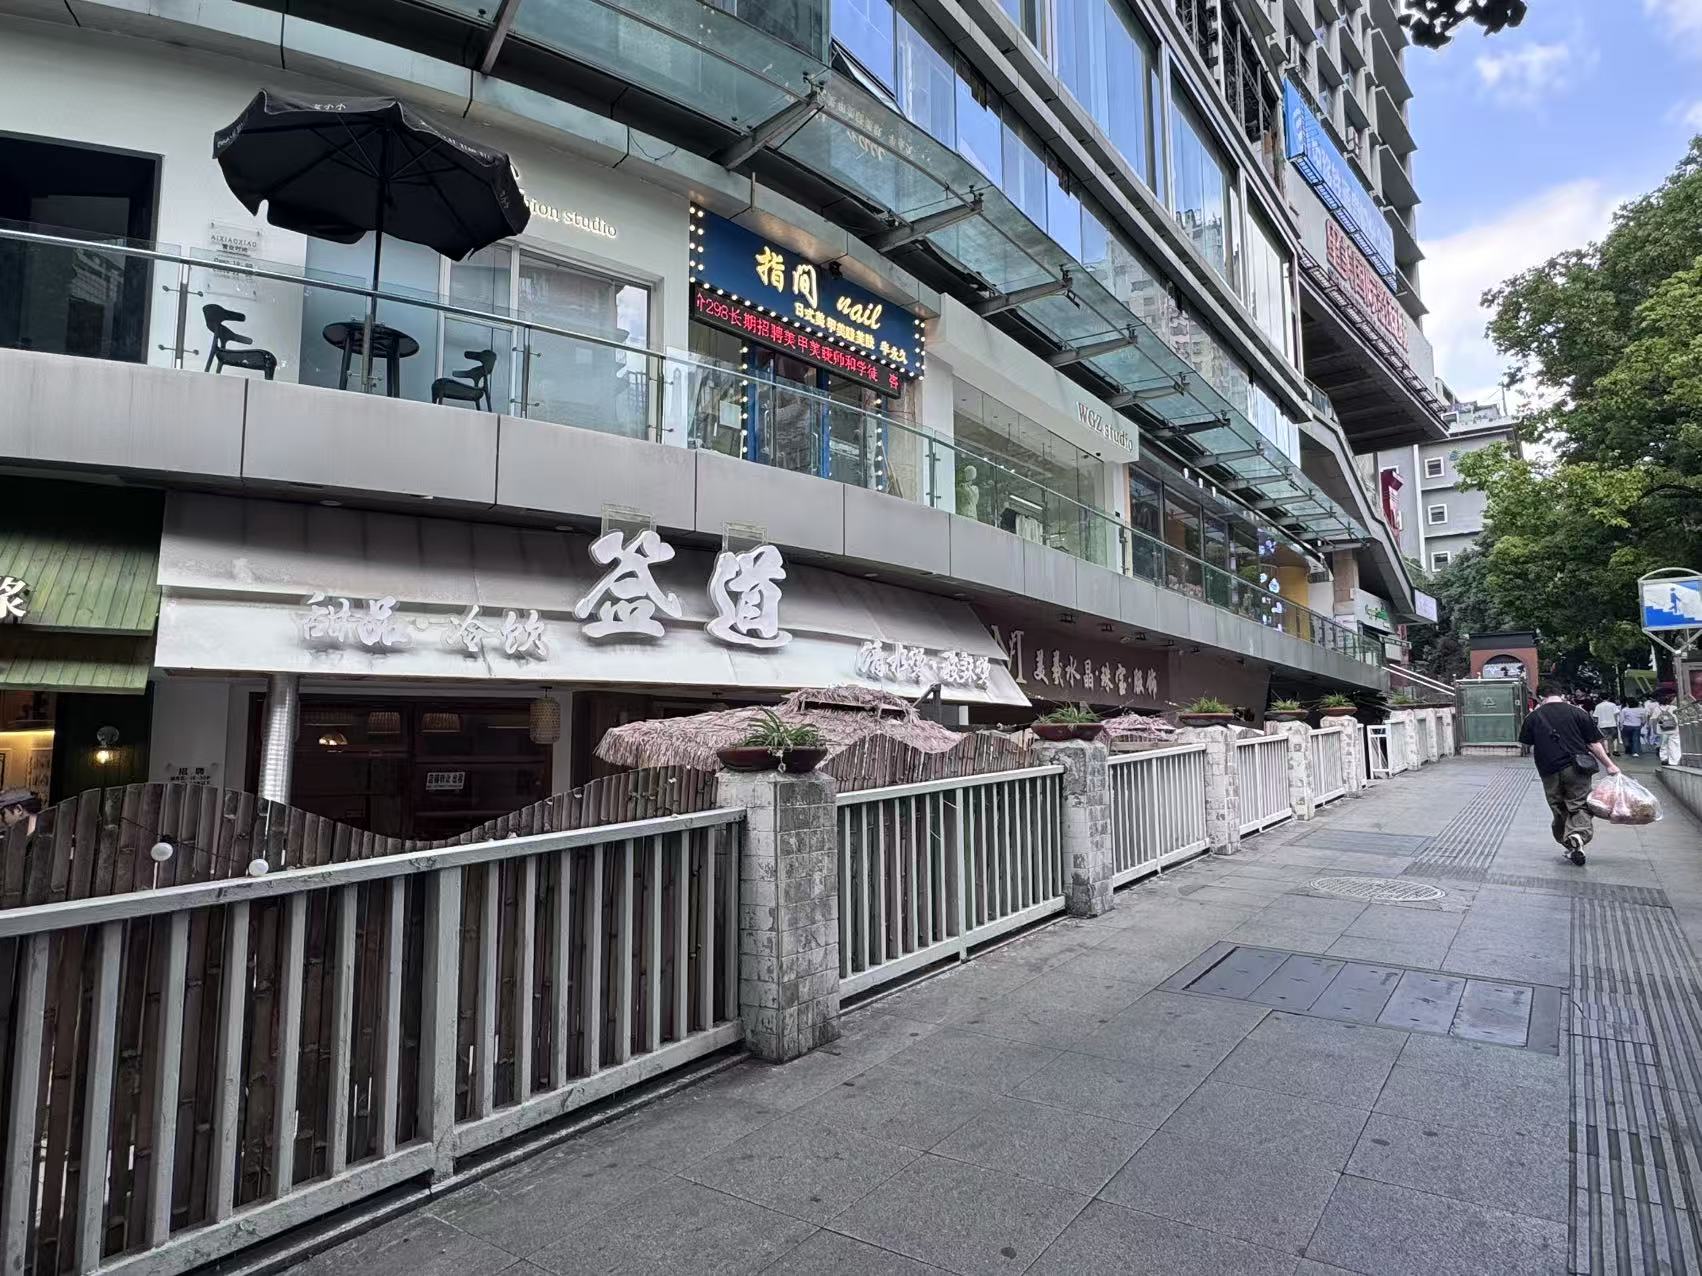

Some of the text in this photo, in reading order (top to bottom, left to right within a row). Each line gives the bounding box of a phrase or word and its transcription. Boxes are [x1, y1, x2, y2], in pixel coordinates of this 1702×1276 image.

[563, 208, 617, 239] studio
[754, 245, 819, 309] 指间
[835, 294, 883, 330] nail
[879, 340, 909, 366] 半永久
[1075, 400, 1135, 454] WGZ studio
